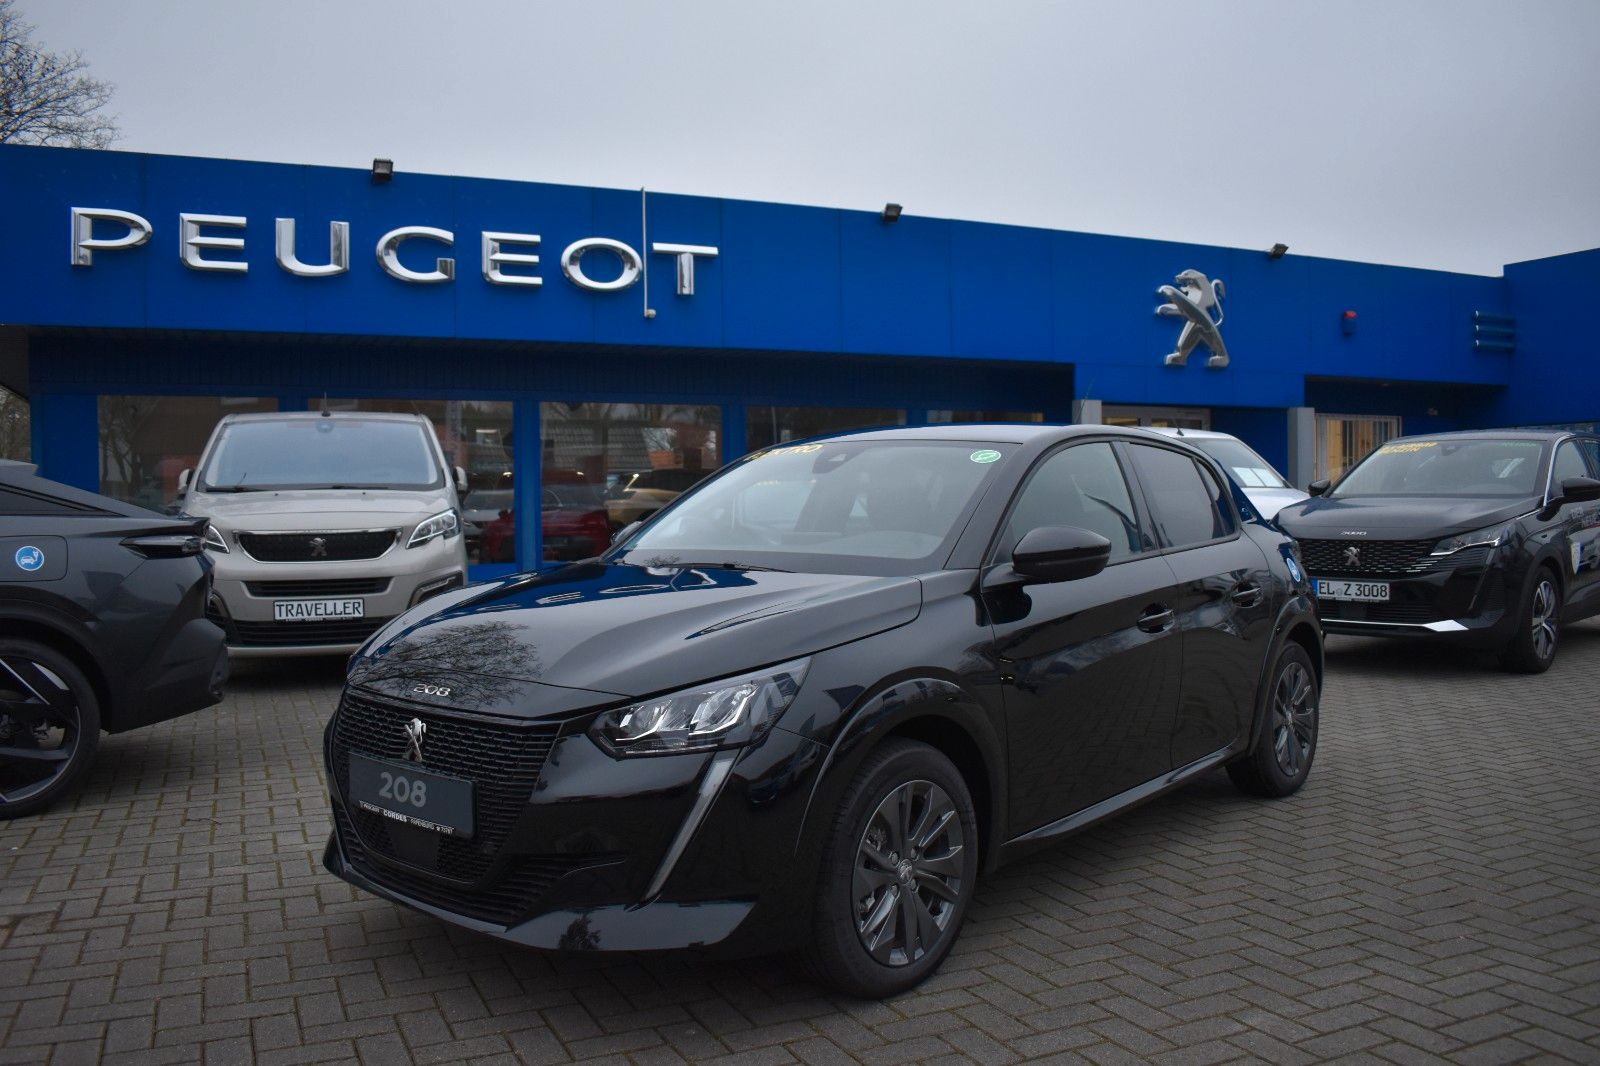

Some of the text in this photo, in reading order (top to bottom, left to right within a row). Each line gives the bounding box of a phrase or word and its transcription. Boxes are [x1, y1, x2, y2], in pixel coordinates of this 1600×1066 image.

[70, 206, 719, 296] PEUGEOT
[1319, 582, 1388, 598] EL Z 3008
[276, 602, 361, 617] TRAVELLER
[413, 683, 451, 697] 208
[379, 771, 427, 808] 208
